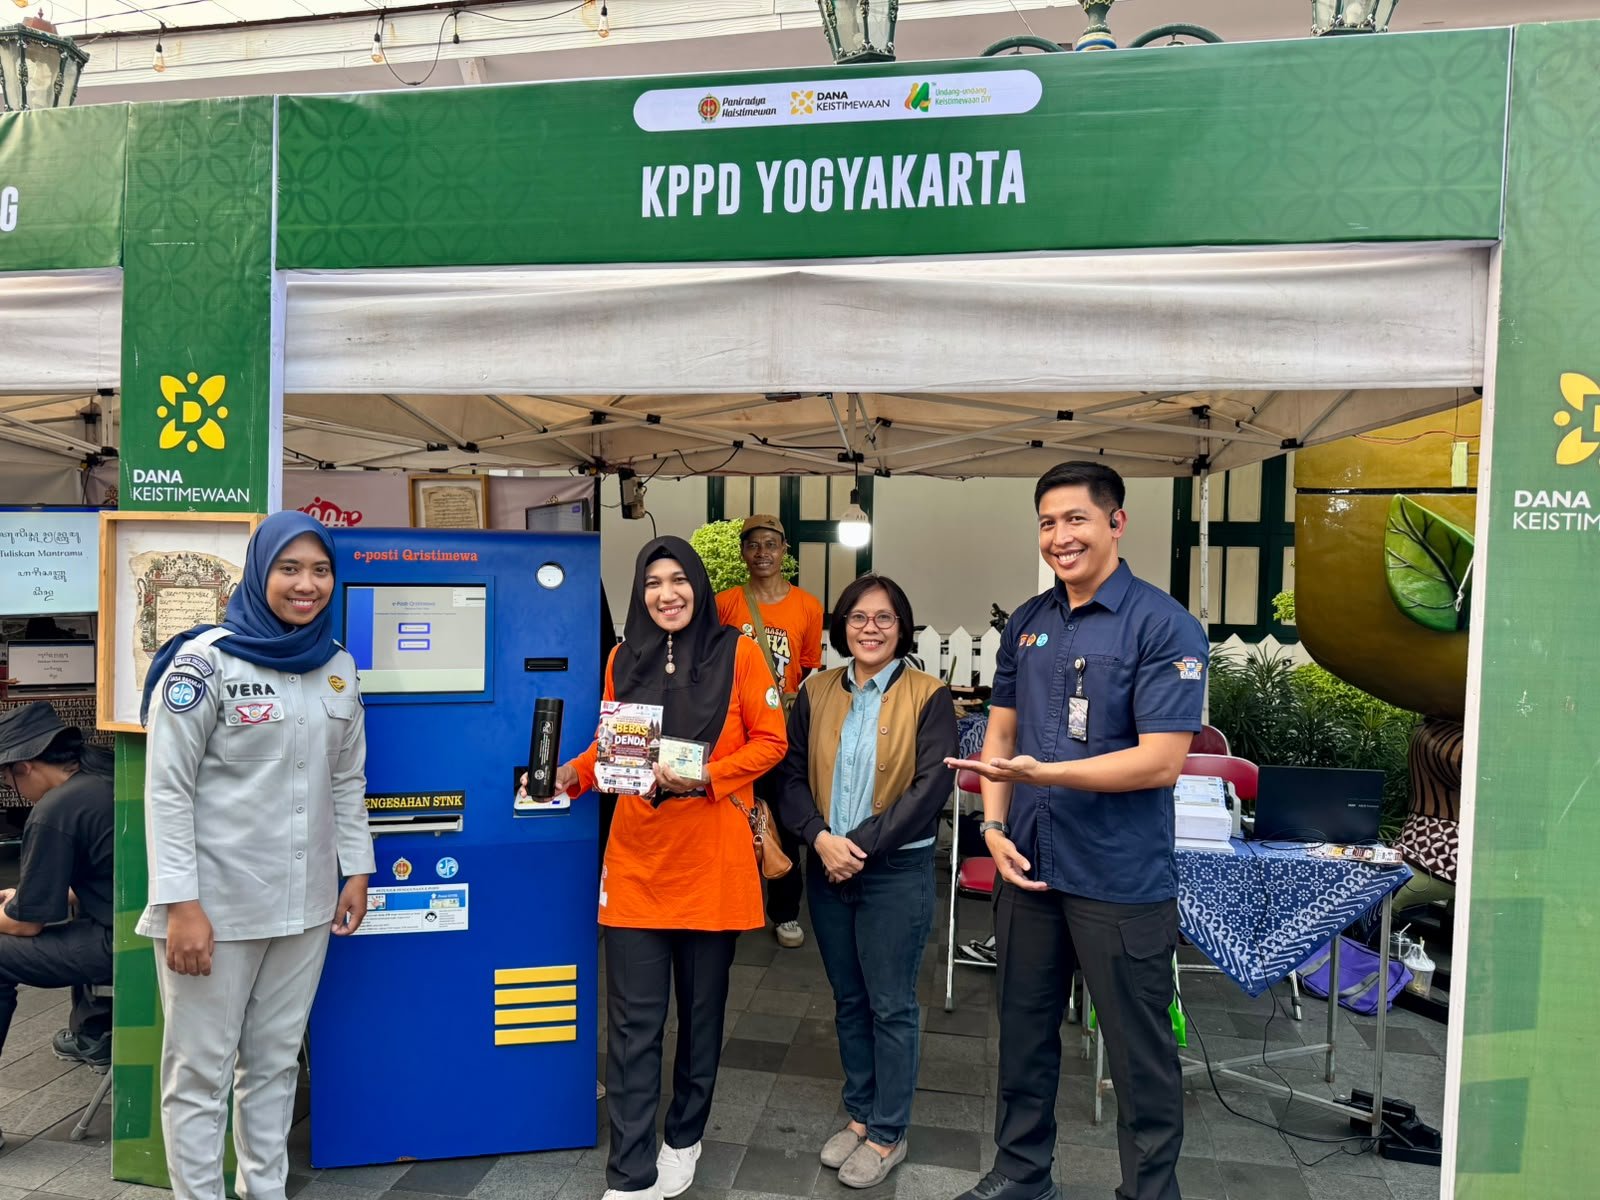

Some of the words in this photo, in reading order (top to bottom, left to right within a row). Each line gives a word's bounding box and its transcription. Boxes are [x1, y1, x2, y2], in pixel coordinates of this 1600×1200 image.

[722, 95, 766, 107] Paniradya
[817, 90, 849, 101] DANA
[816, 99, 890, 111] KEISTIMEWAAN
[641, 162, 741, 218] KPPD
[756, 149, 1027, 214] YOGYAKARTA
[0, 186, 19, 232] G
[133, 469, 183, 484] DANA
[132, 487, 250, 503] KEISTIMEWAAN
[1514, 490, 1591, 509] DANA
[1513, 511, 1600, 531] KEISTIM
[354, 549, 399, 564] e-posti
[402, 548, 478, 561] Qristimewa
[226, 683, 275, 698] VERA
[616, 723, 649, 736] BEBAS
[614, 735, 646, 747] DENDA
[364, 796, 430, 809] ENGESAHAN
[433, 795, 462, 807] STNK
